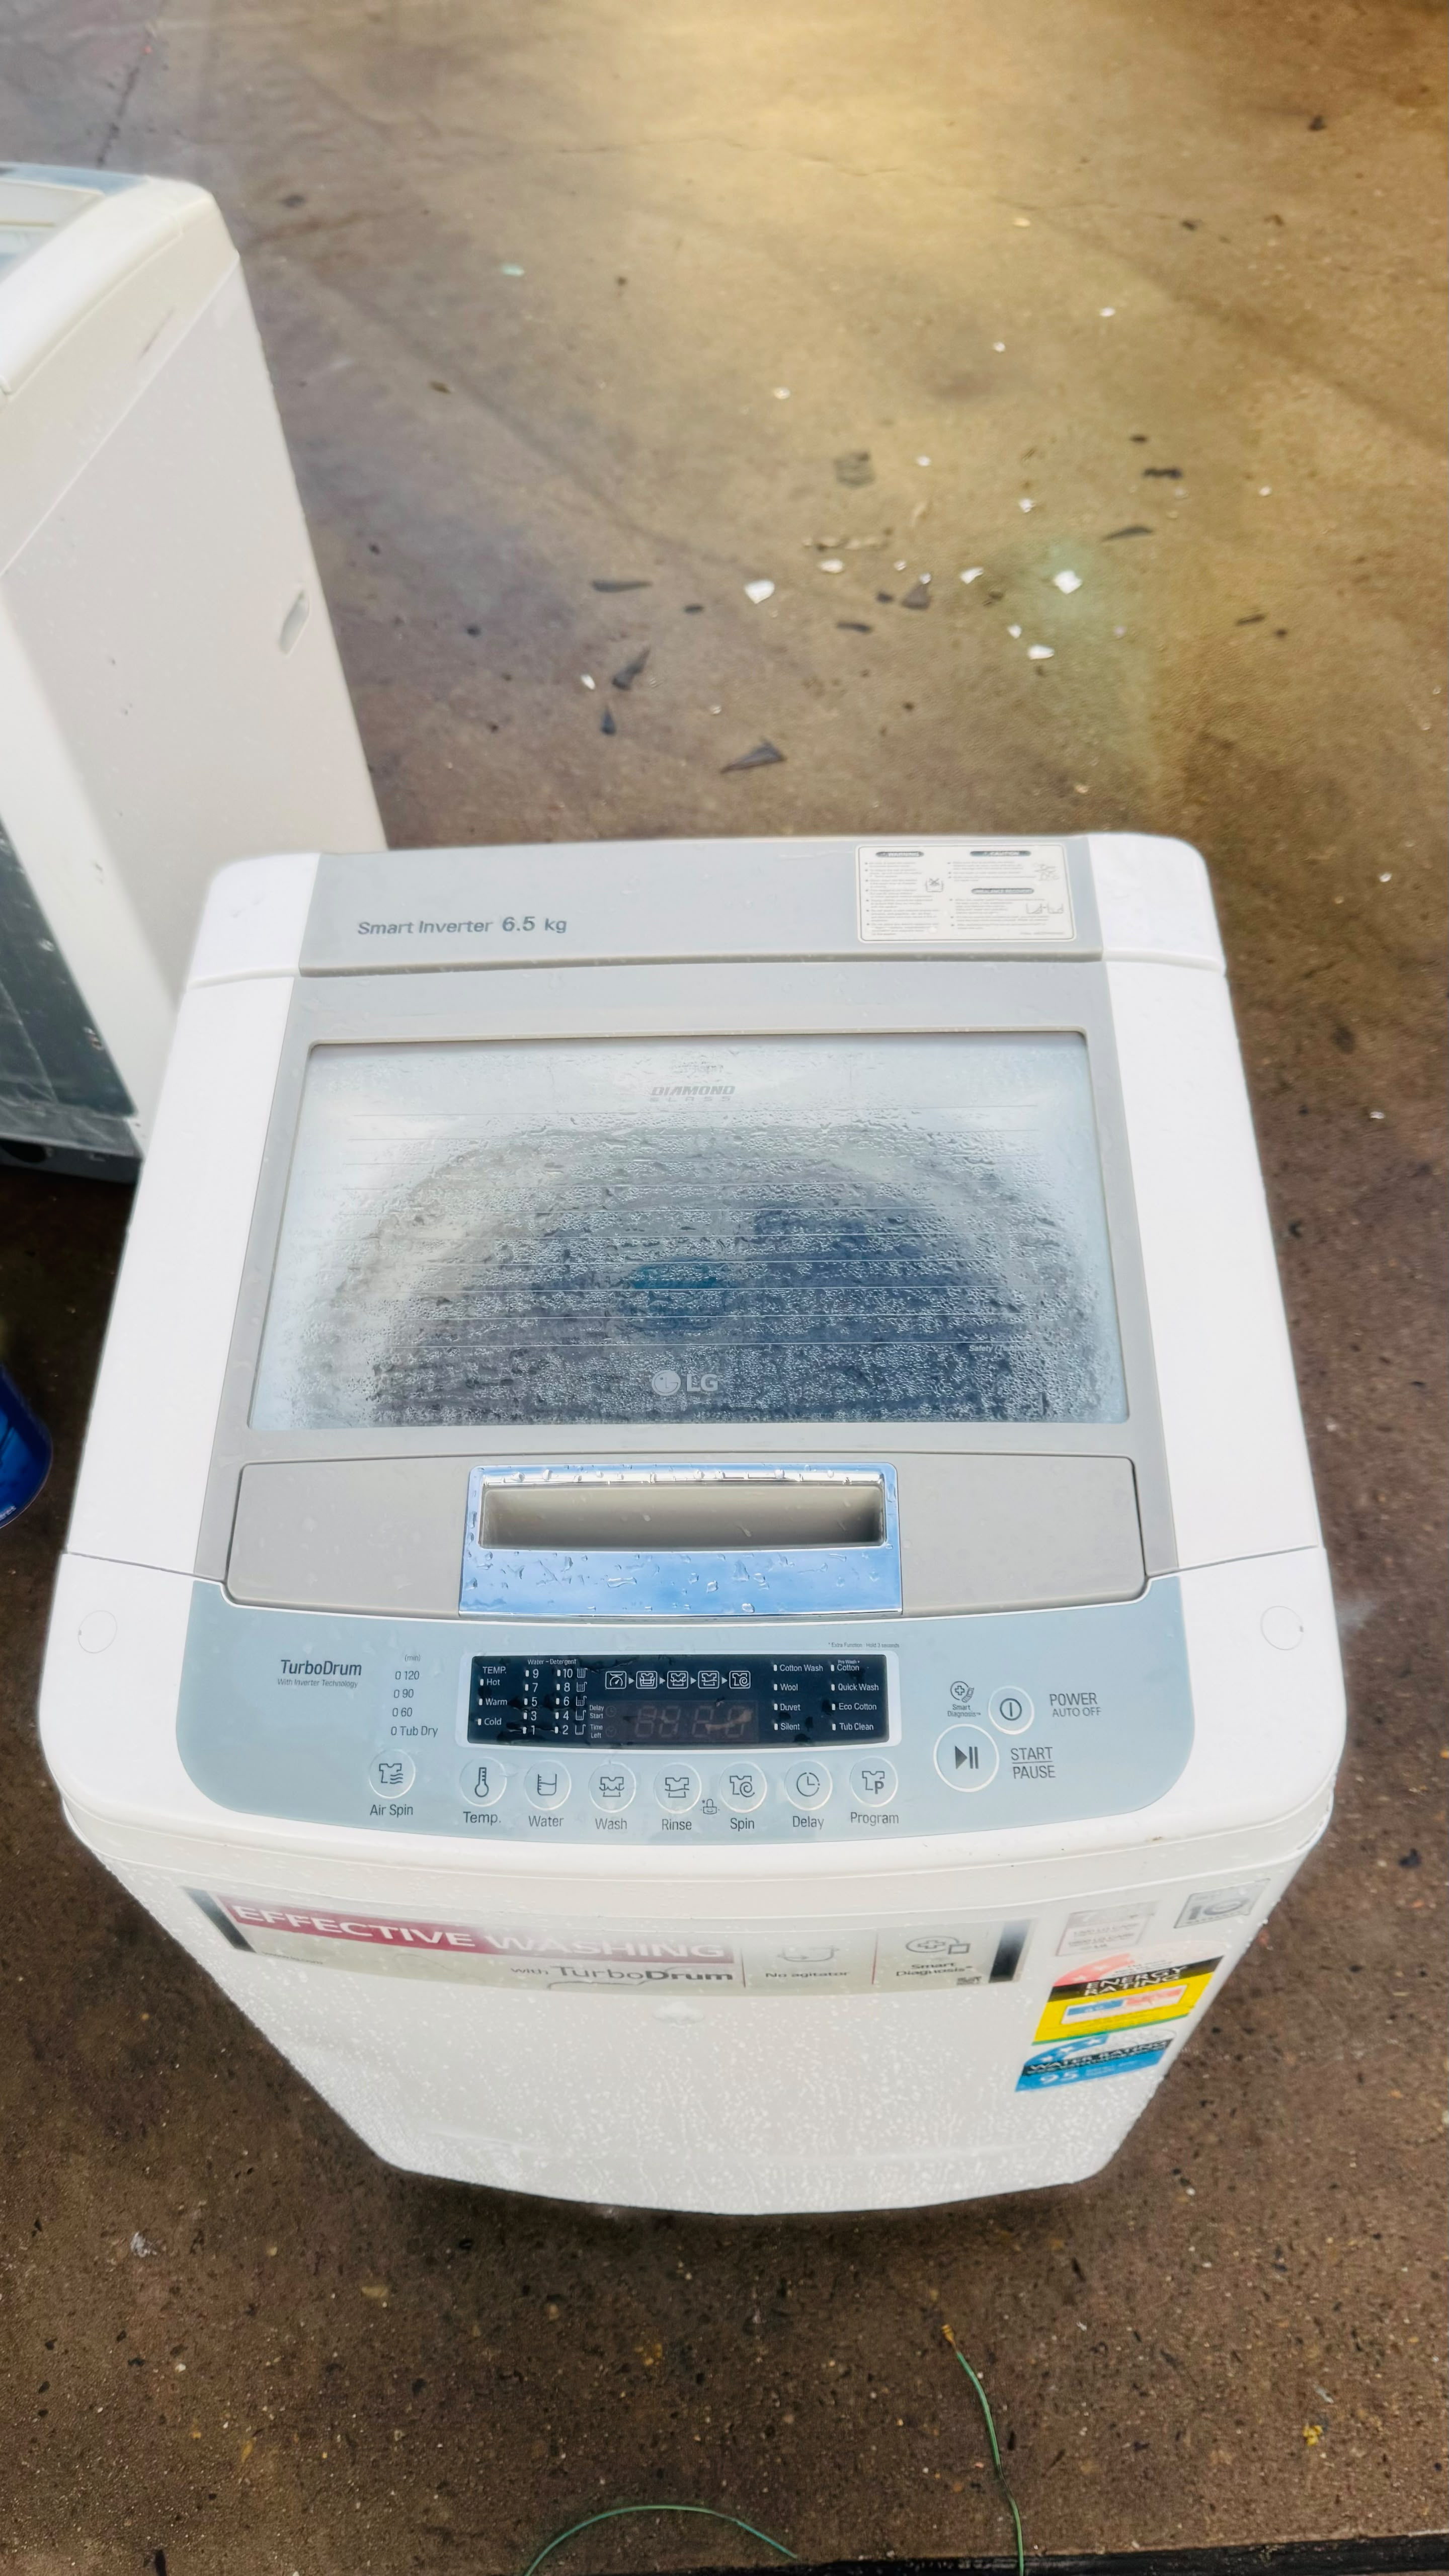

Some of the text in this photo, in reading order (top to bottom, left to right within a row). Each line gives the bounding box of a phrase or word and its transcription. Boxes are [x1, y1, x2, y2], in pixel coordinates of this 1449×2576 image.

[358, 916, 567, 935] Smart Inverter 6.5 kg
[651, 1086, 736, 1096] DIAMOND
[686, 1374, 718, 1392] LG
[405, 1654, 421, 1662] (min)
[281, 1659, 362, 1676] TurboDrum
[482, 1666, 507, 1674] TEMP.
[532, 1668, 573, 1678] 9 10
[405, 1670, 420, 1680] 120
[322, 1679, 358, 1688] Technology
[532, 1682, 571, 1693] 7 8
[838, 1683, 858, 1691] Quick
[402, 1688, 414, 1698] 90
[531, 1697, 570, 1707] 5 6
[1049, 1693, 1098, 1706] POWER
[400, 1708, 413, 1717] 60
[531, 1711, 569, 1721] 3 4
[1053, 1707, 1102, 1717] AUTO OFF
[400, 1726, 438, 1738] Tub Dry
[531, 1725, 569, 1735] 1 2
[1010, 1747, 1053, 1761] START
[1013, 1765, 1056, 1779] PAUSE
[370, 1804, 414, 1818] Air Spin
[463, 1811, 502, 1825] Temp.
[529, 1815, 564, 1827] Water
[595, 1818, 628, 1830] Wash
[792, 1816, 824, 1830] Delay
[851, 1812, 899, 1827] Program
[662, 1818, 692, 1831] Rinse
[730, 1817, 755, 1833] Spin
[231, 1905, 725, 1958] EFFECTIVE WASHING
[511, 1965, 733, 1981] with TurboDrum
[791, 1971, 849, 1979] agitator
[1086, 1965, 1188, 1989] ENERGY
[1083, 1973, 1180, 1996] RATING
